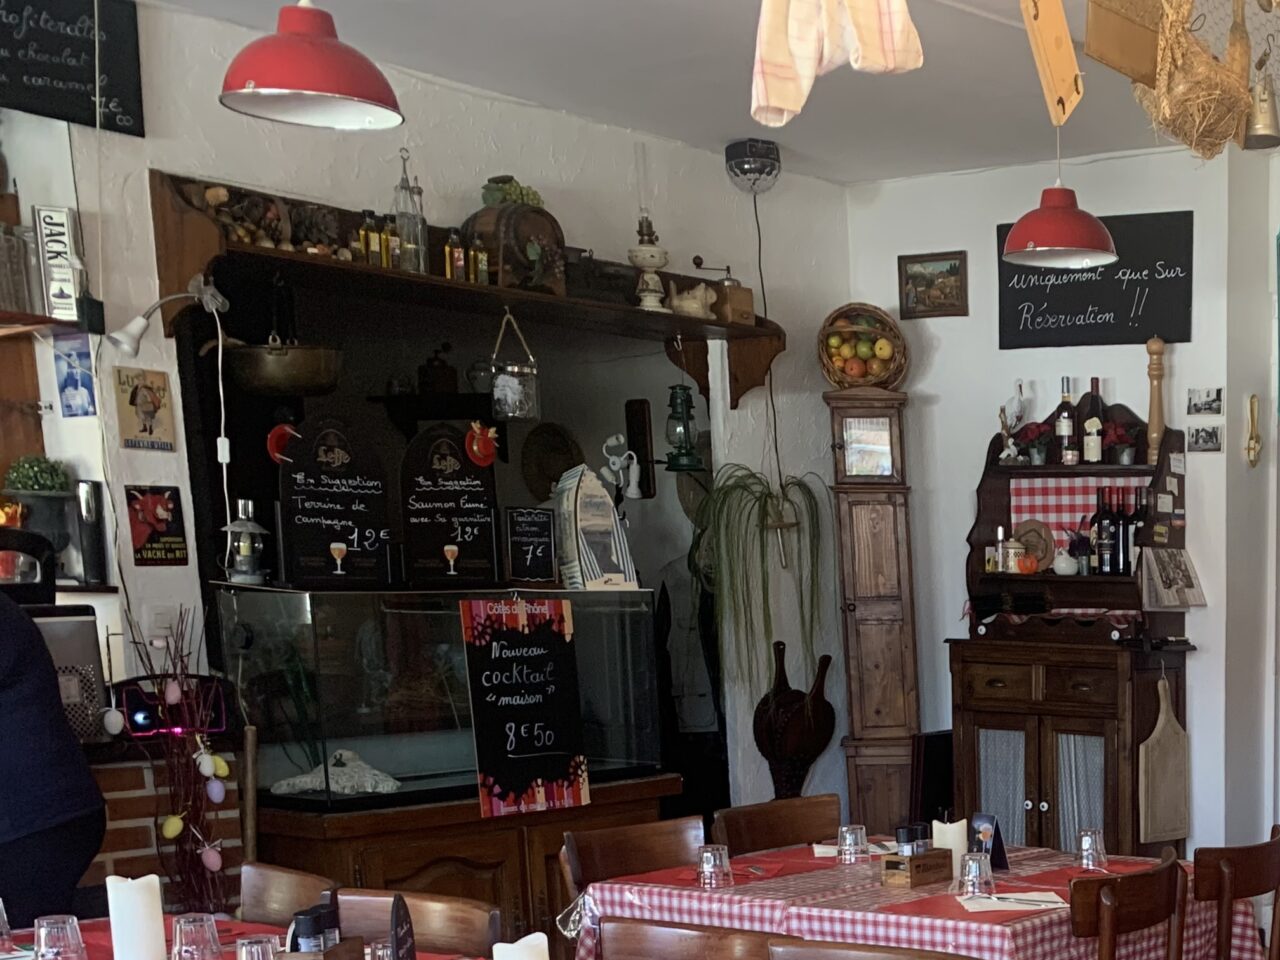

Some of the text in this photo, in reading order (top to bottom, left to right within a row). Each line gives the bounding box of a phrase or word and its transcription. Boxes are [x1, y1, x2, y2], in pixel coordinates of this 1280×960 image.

[42, 213, 68, 262] JACK
[1115, 267, 1149, 290] que
[1018, 302, 1116, 331] Réservation
[316, 446, 351, 468] Leffe
[431, 455, 461, 475] Leffe
[292, 496, 369, 512] Terrine de
[407, 495, 457, 510] Saumon
[521, 544, 546, 566] 7€
[491, 641, 550, 660] Nouveau
[481, 662, 555, 687] cocktail
